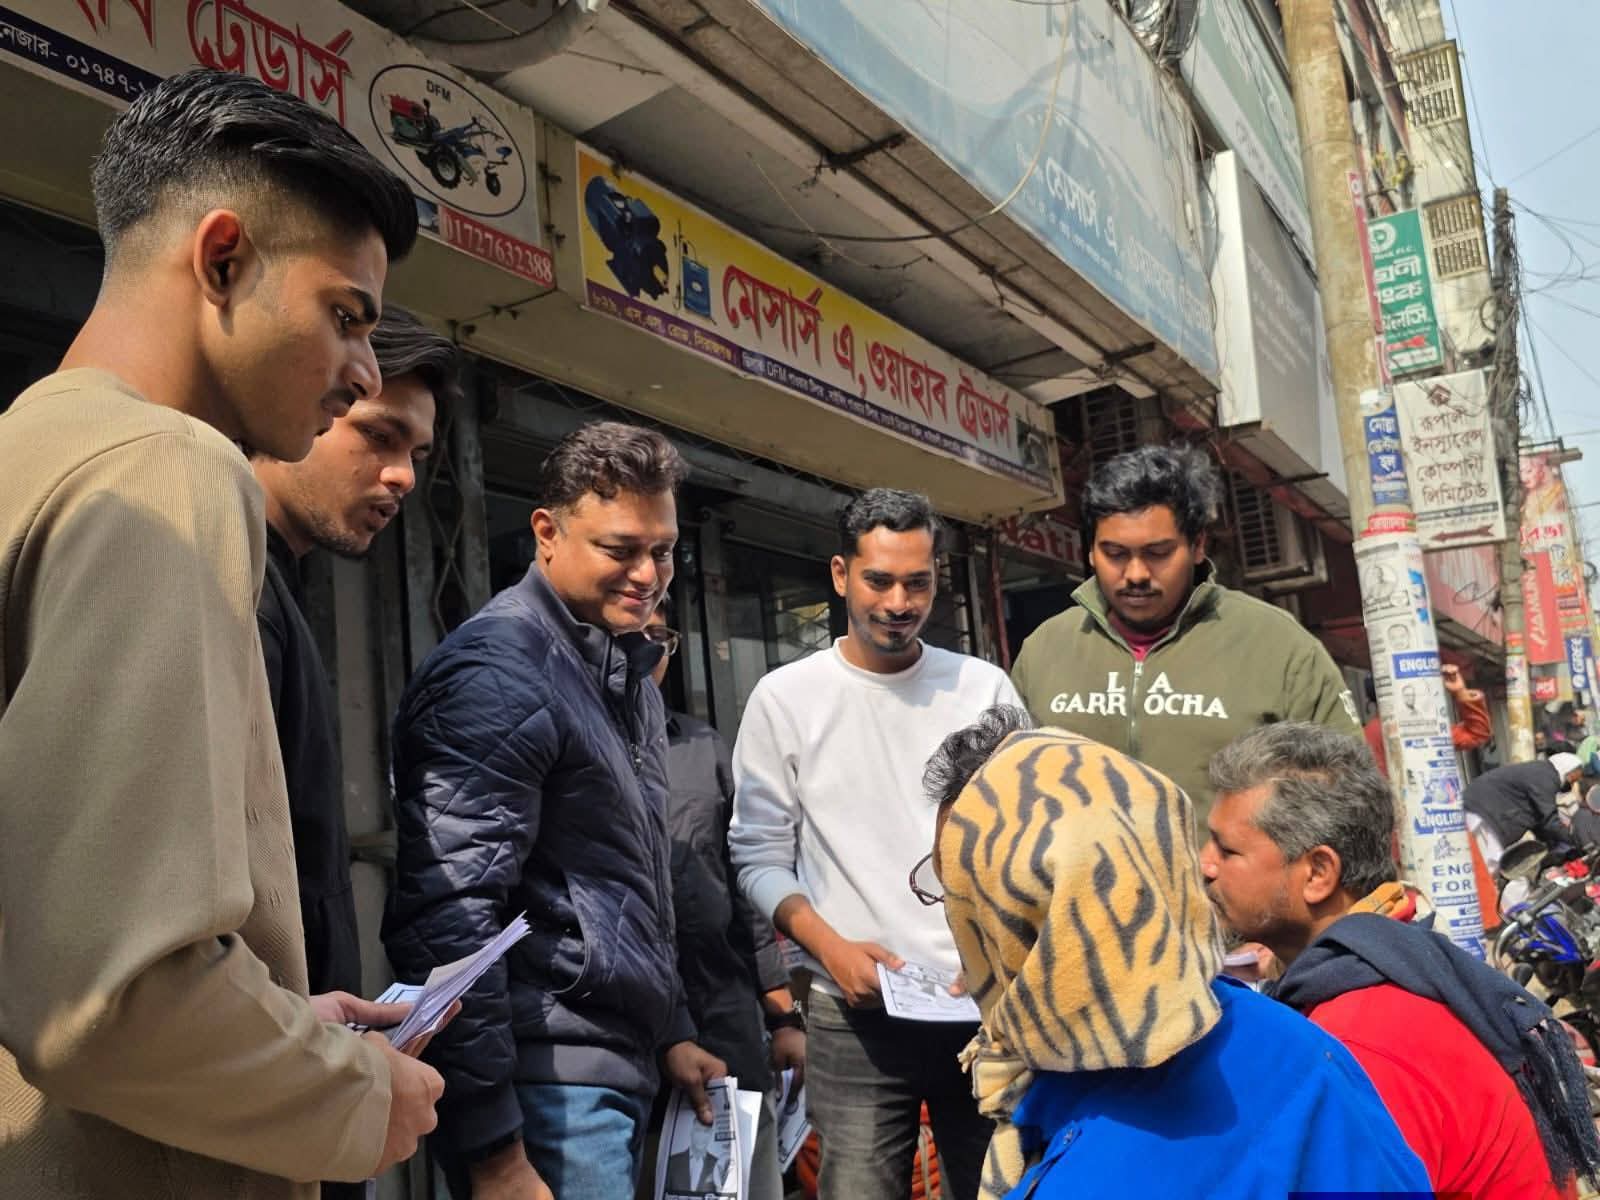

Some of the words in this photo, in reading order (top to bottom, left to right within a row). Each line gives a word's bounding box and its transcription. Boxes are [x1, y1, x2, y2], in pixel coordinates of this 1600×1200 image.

[426, 79, 451, 103] DFM
[722, 264, 824, 368] মেসার্স
[956, 367, 1011, 449] ট্রেডার্স
[1422, 482, 1489, 506] লিমিটেড
[1399, 656, 1440, 672] ENGLIS
[1570, 637, 1585, 674] GREE
[1431, 879, 1472, 893] FOR
